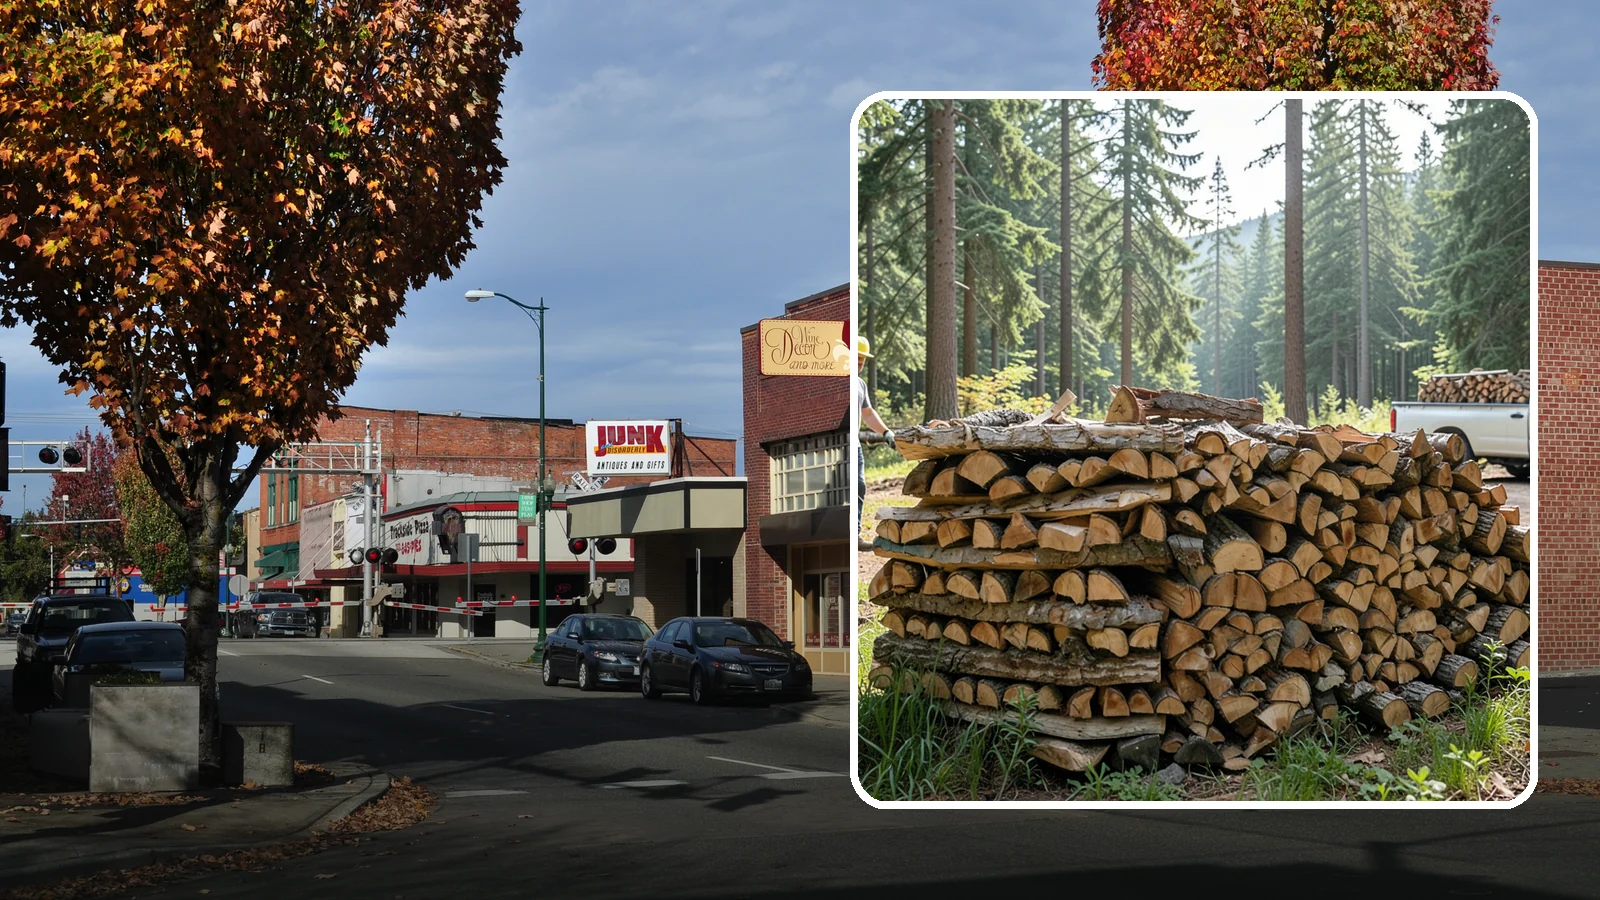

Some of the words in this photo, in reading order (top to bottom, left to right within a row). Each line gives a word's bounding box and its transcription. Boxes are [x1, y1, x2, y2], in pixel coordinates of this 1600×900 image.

[596, 425, 664, 457] JUNK
[607, 446, 646, 454] DISORDERLY
[597, 460, 628, 470] ANTIQUES
[631, 460, 644, 470] AND
[646, 460, 665, 470] GIFTS
[352, 498, 364, 510] CRO
[390, 521, 413, 539] Trackside
[414, 519, 429, 534] Pizza
